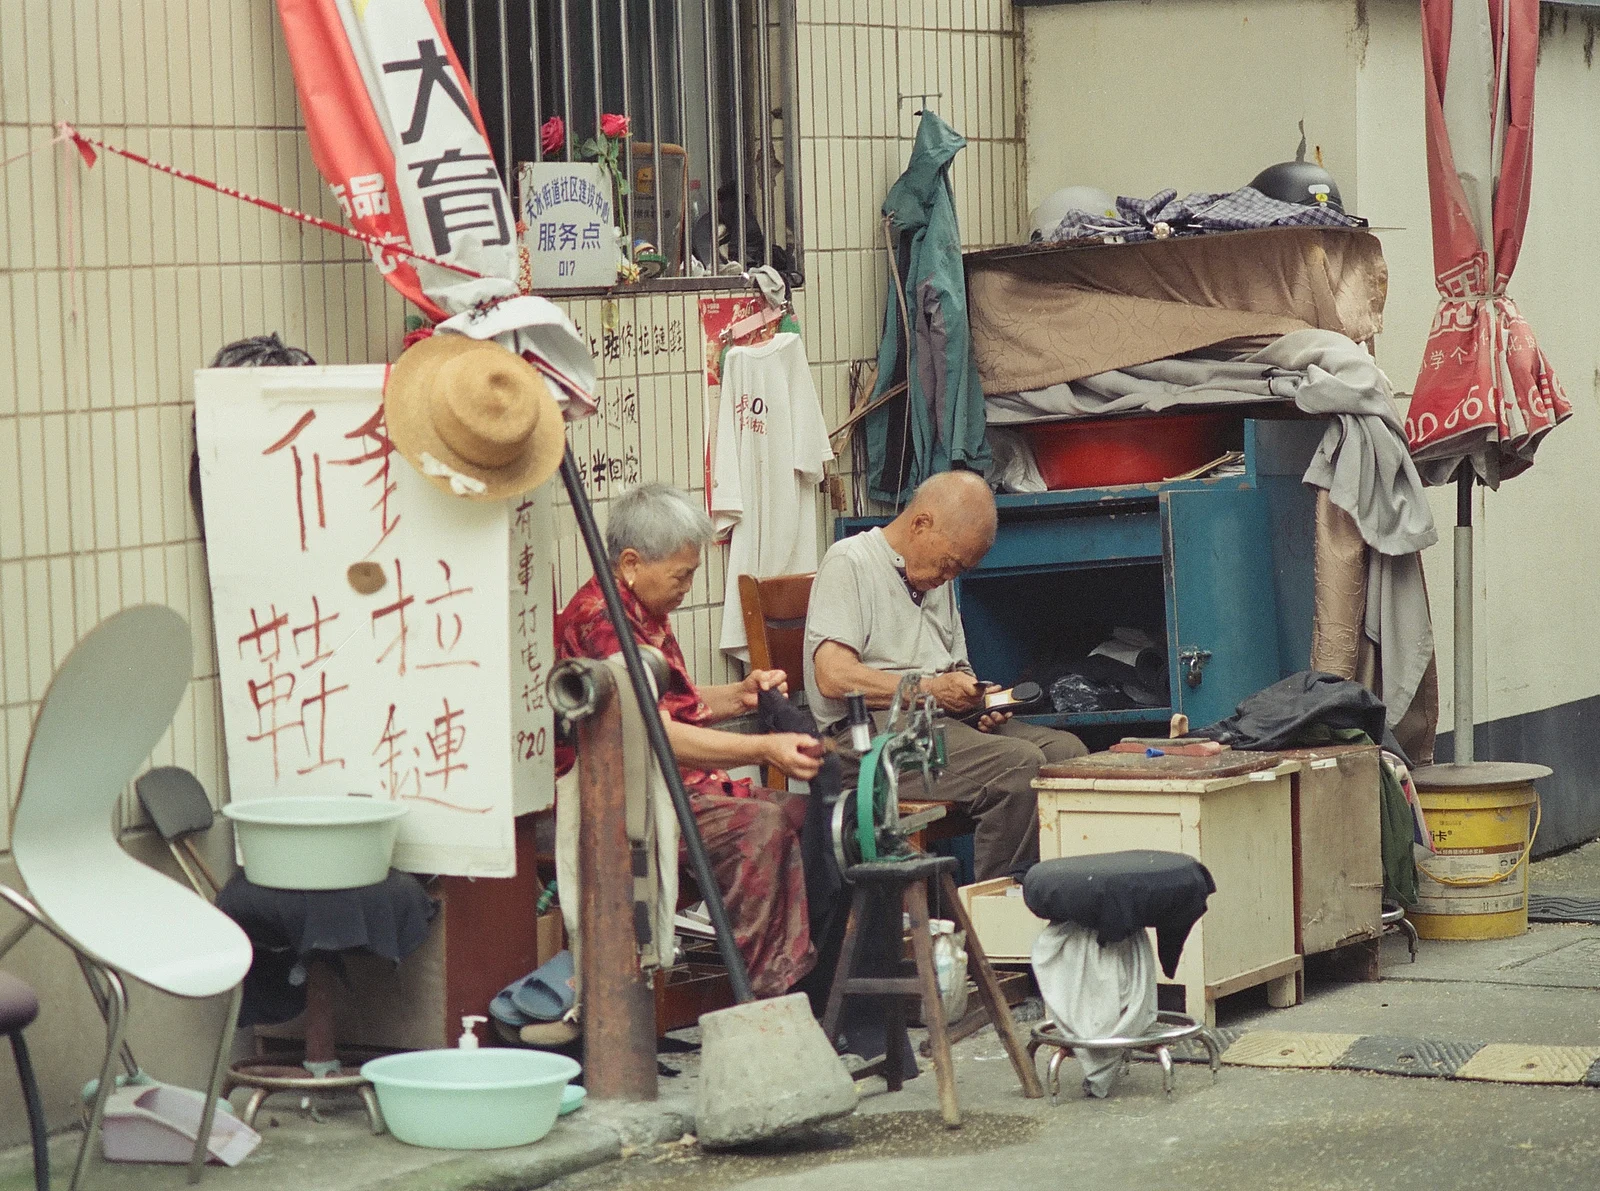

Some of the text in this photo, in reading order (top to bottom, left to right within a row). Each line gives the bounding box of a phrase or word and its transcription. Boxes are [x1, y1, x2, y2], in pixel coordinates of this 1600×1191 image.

[538, 222, 601, 252] 服务点
[558, 260, 576, 277] 017
[238, 596, 351, 786] 鞋
